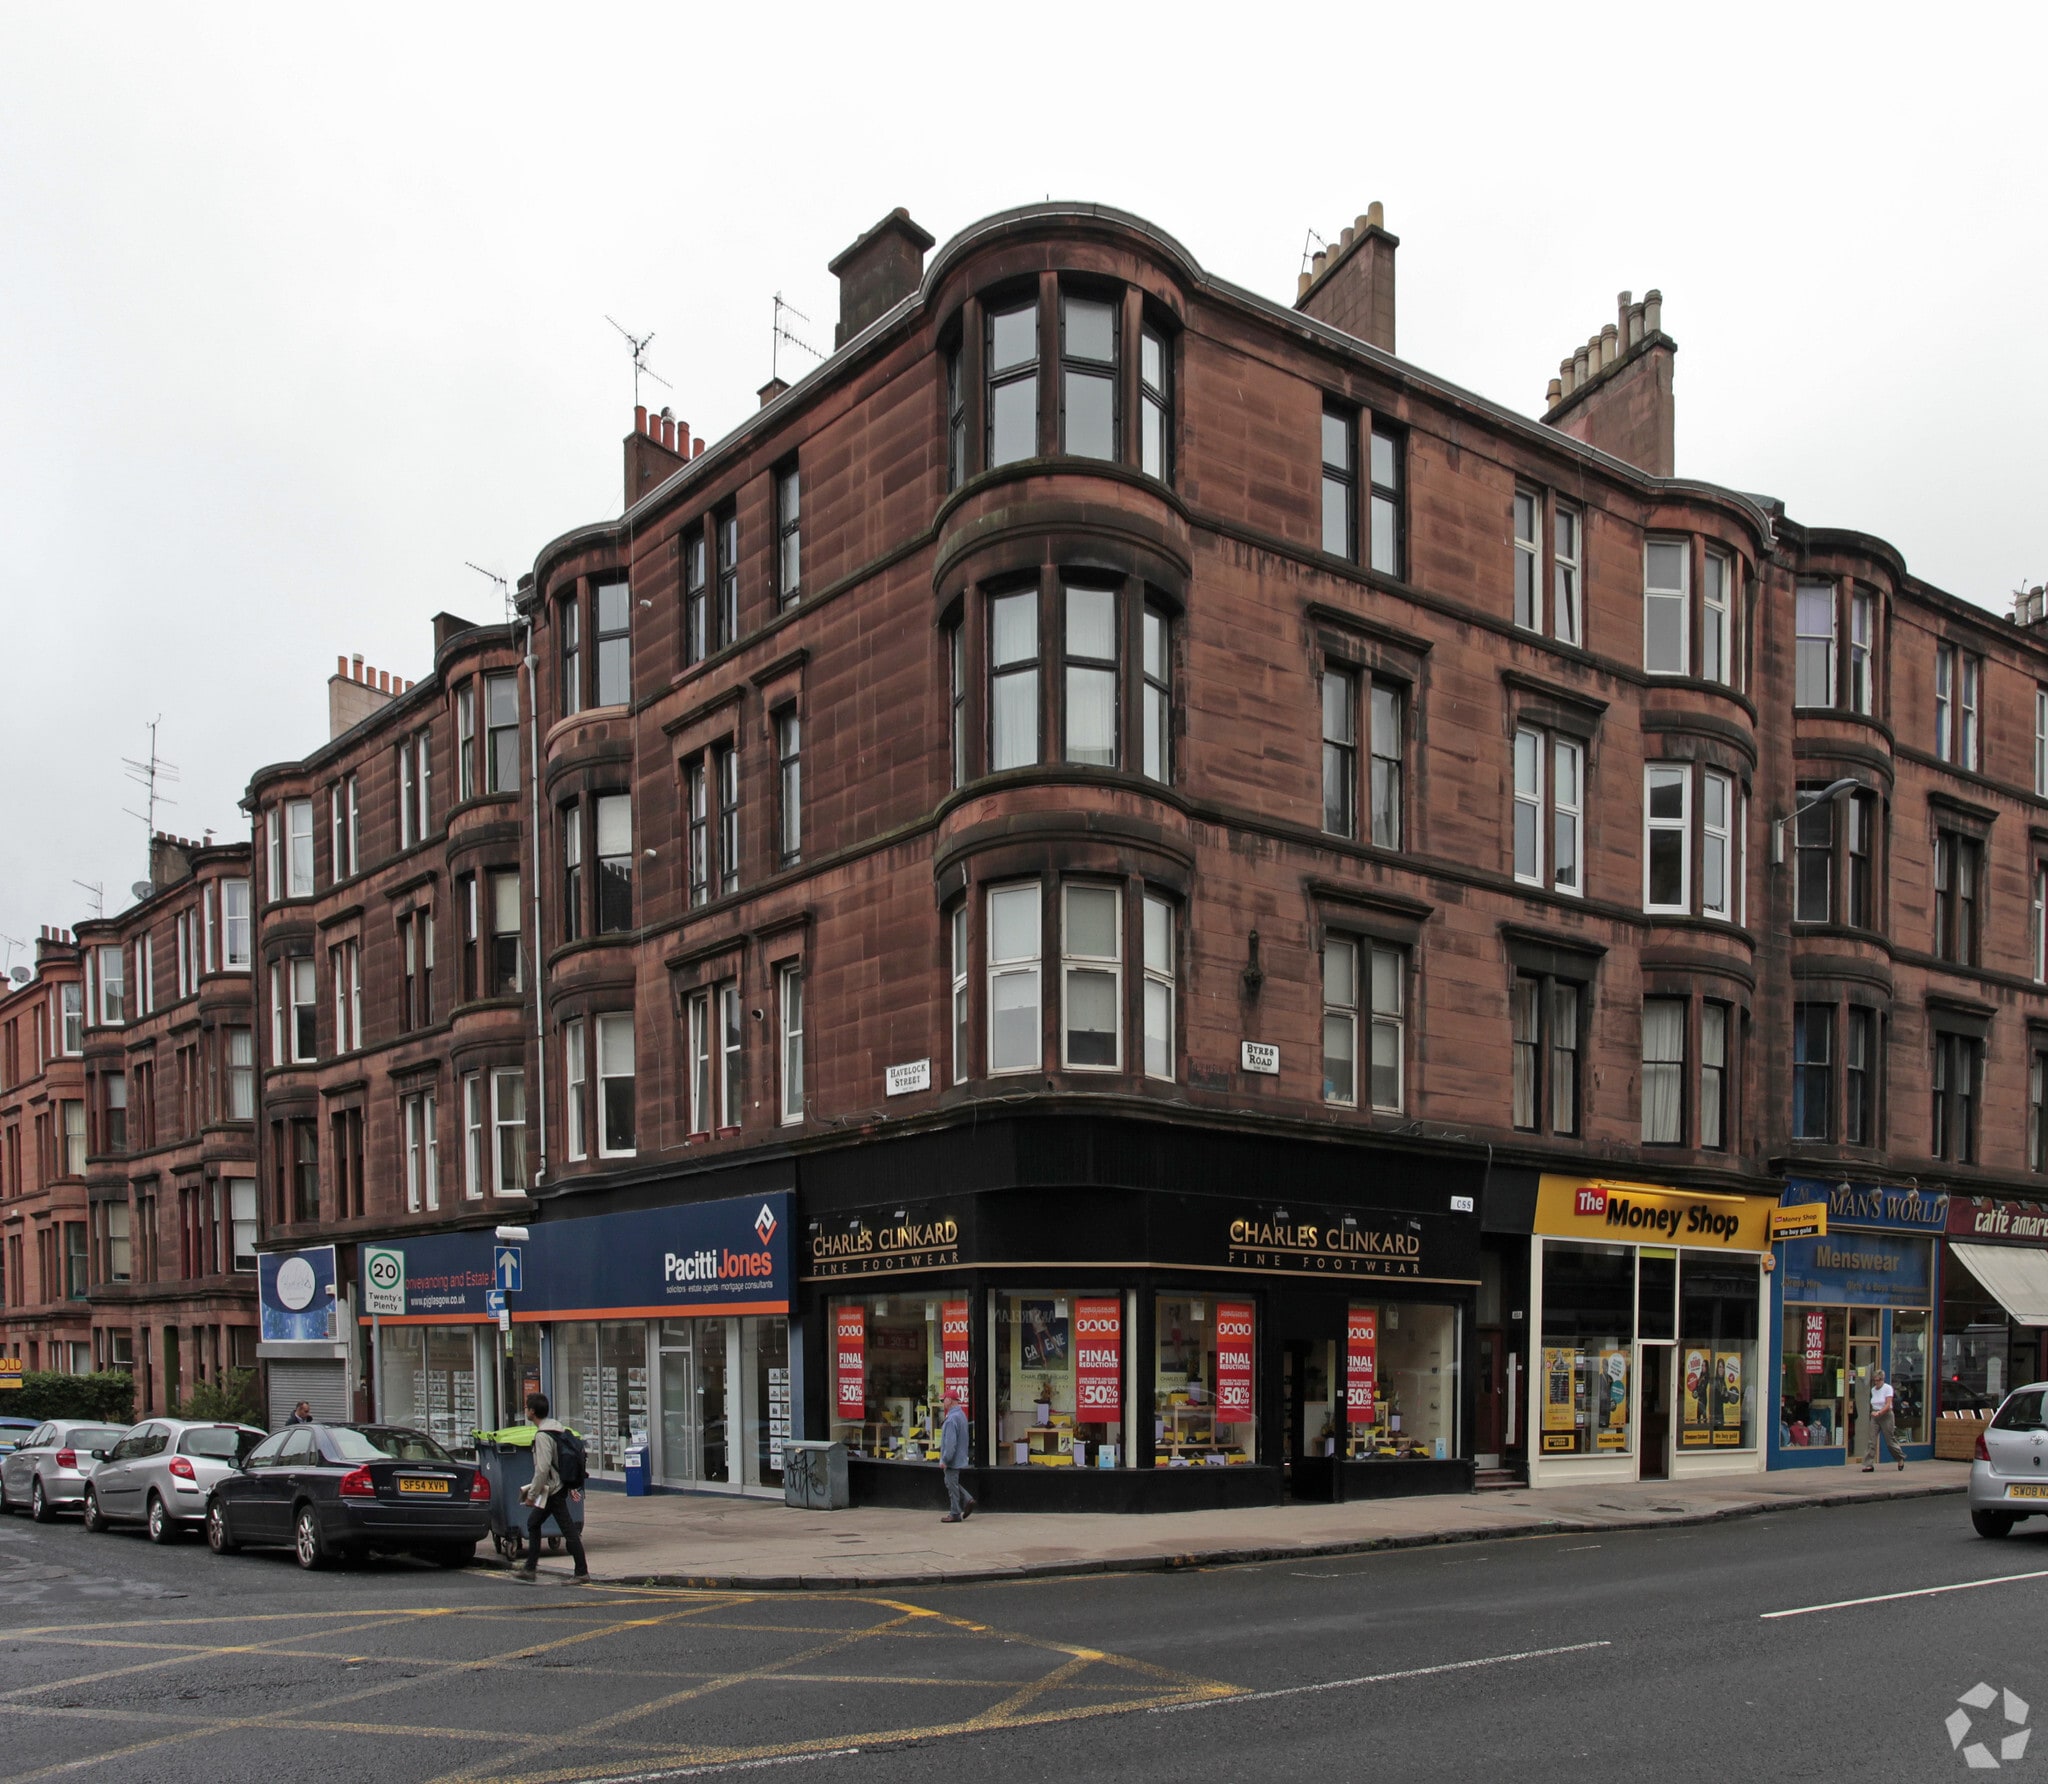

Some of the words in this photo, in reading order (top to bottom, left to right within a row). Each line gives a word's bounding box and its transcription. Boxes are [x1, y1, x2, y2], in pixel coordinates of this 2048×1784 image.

[1247, 1044, 1274, 1056] BYRES
[1249, 1054, 1272, 1066] ROAD
[891, 1064, 926, 1078] HAVELOCK
[895, 1076, 920, 1087] STREET
[1829, 1191, 1881, 1219] MAN'S
[1886, 1196, 1944, 1223] WORLD
[1579, 1192, 1604, 1211] The
[1606, 1198, 1682, 1238] Money
[1687, 1205, 1739, 1241] Shop
[1229, 1220, 1318, 1249] CHARLES
[1326, 1227, 1420, 1255] CLINKARD
[1789, 1228, 1799, 1236] buy
[1800, 1226, 1812, 1235] gold
[813, 1230, 873, 1257] CHARLES
[879, 1220, 958, 1250] CLINKARD
[813, 1263, 848, 1276] FINE
[862, 1251, 959, 1271] FOOTWEAR
[1228, 1252, 1280, 1266] FINE
[1303, 1257, 1420, 1275] FOOTWEAR
[1816, 1245, 1900, 1272] Menswear
[373, 1263, 396, 1279] 20
[450, 1273, 464, 1287] and
[466, 1271, 489, 1286] Estate
[703, 1283, 718, 1294] agents
[368, 1292, 402, 1302] Twenty's
[410, 1294, 466, 1308] www.pjglasgow.co.uk
[373, 1302, 398, 1311] Plenty
[944, 1321, 968, 1333] SAL
[1078, 1320, 1119, 1332] SALE
[1219, 1322, 1251, 1335] SALE
[1806, 1315, 1822, 1330] SALE
[838, 1325, 863, 1336] SALE
[1348, 1328, 1374, 1339] ALE
[1806, 1332, 1822, 1348] 50%
[839, 1353, 862, 1363] FINAL
[1079, 1350, 1118, 1362] FINAL
[1219, 1352, 1250, 1364] FINAL
[1806, 1350, 1822, 1358] OFF
[842, 1385, 862, 1401] 50%
[1085, 1385, 1118, 1403] 50%
[1224, 1387, 1249, 1404] 50%
[1347, 1388, 1371, 1405] 50%
[403, 1480, 426, 1490] SF54
[428, 1481, 445, 1490] XVH
[2013, 1486, 2038, 1496] SW08
